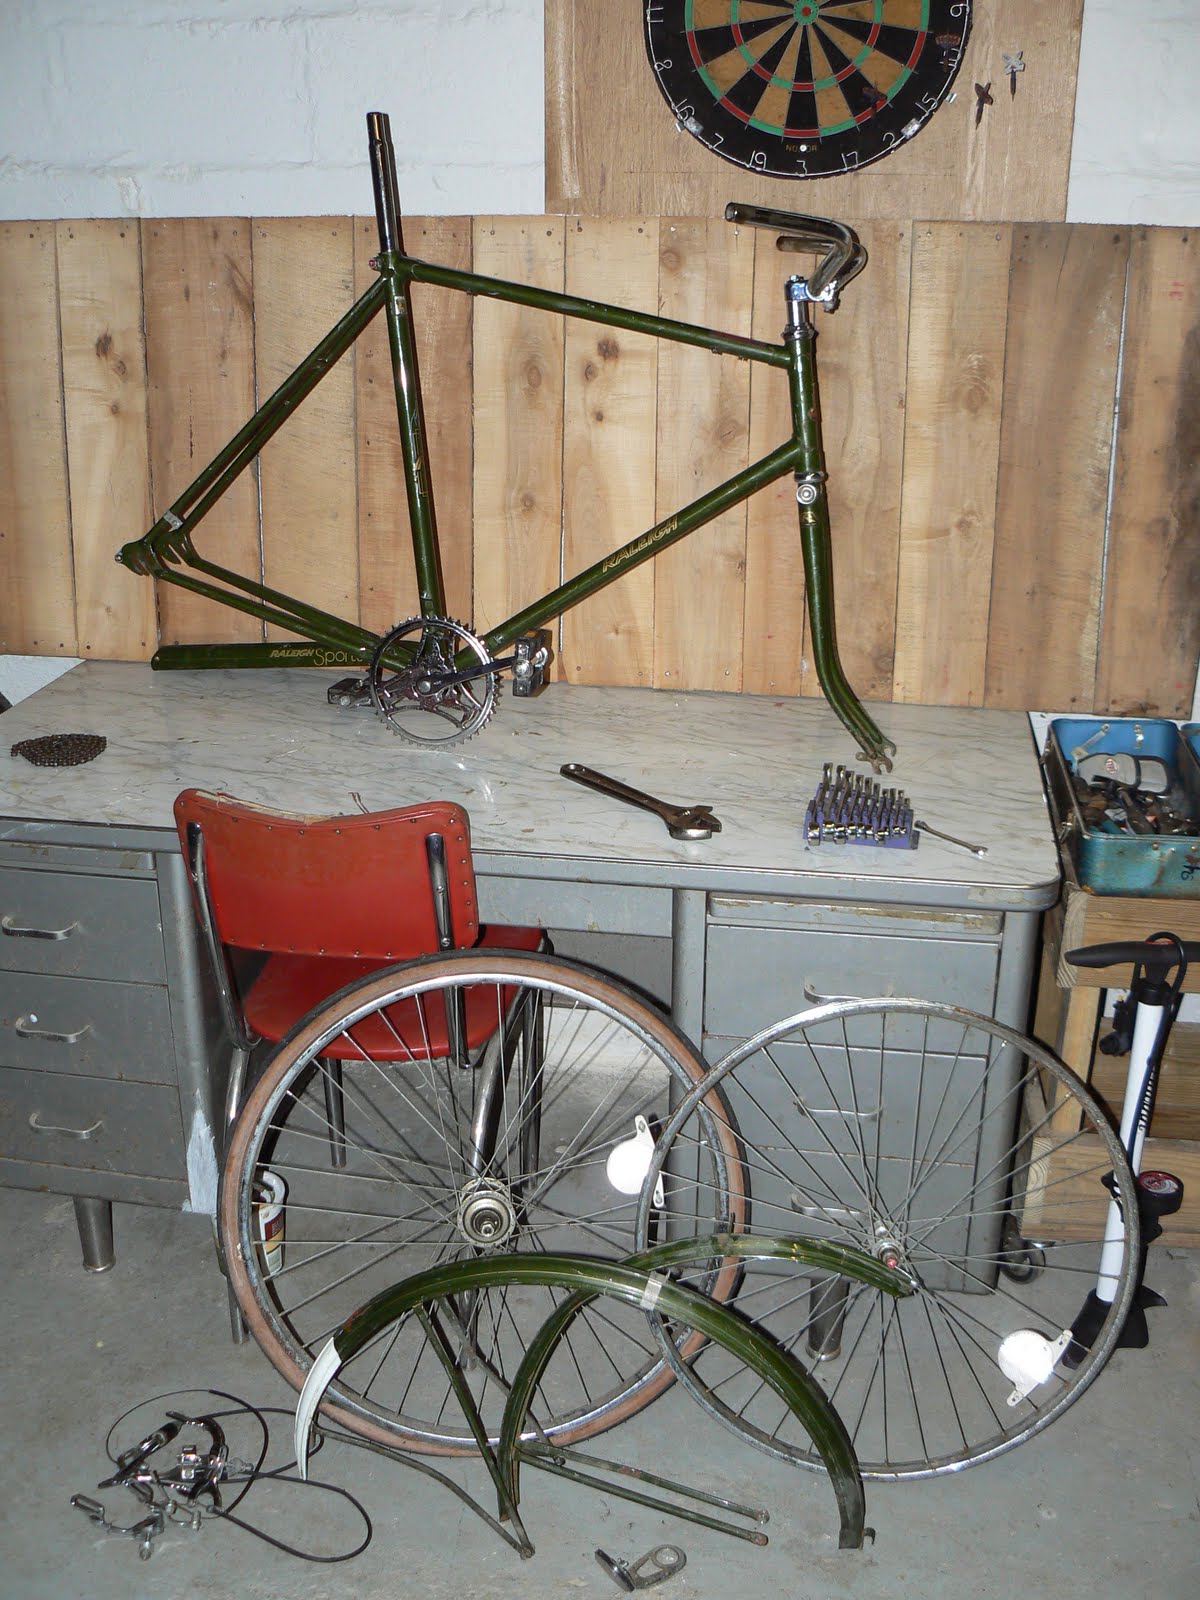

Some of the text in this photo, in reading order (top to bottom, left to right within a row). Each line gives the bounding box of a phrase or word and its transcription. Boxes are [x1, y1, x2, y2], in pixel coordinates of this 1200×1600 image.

[654, 59, 672, 72] 8
[915, 92, 938, 114] 15
[709, 132, 724, 149] 7
[785, 144, 817, 153] NOOR
[882, 132, 900, 148] 2
[748, 150, 767, 171] 19
[795, 160, 808, 177] 3
[841, 151, 859, 170] 17
[602, 515, 678, 573] RALEIGH
[269, 648, 315, 658] RALEIGH
